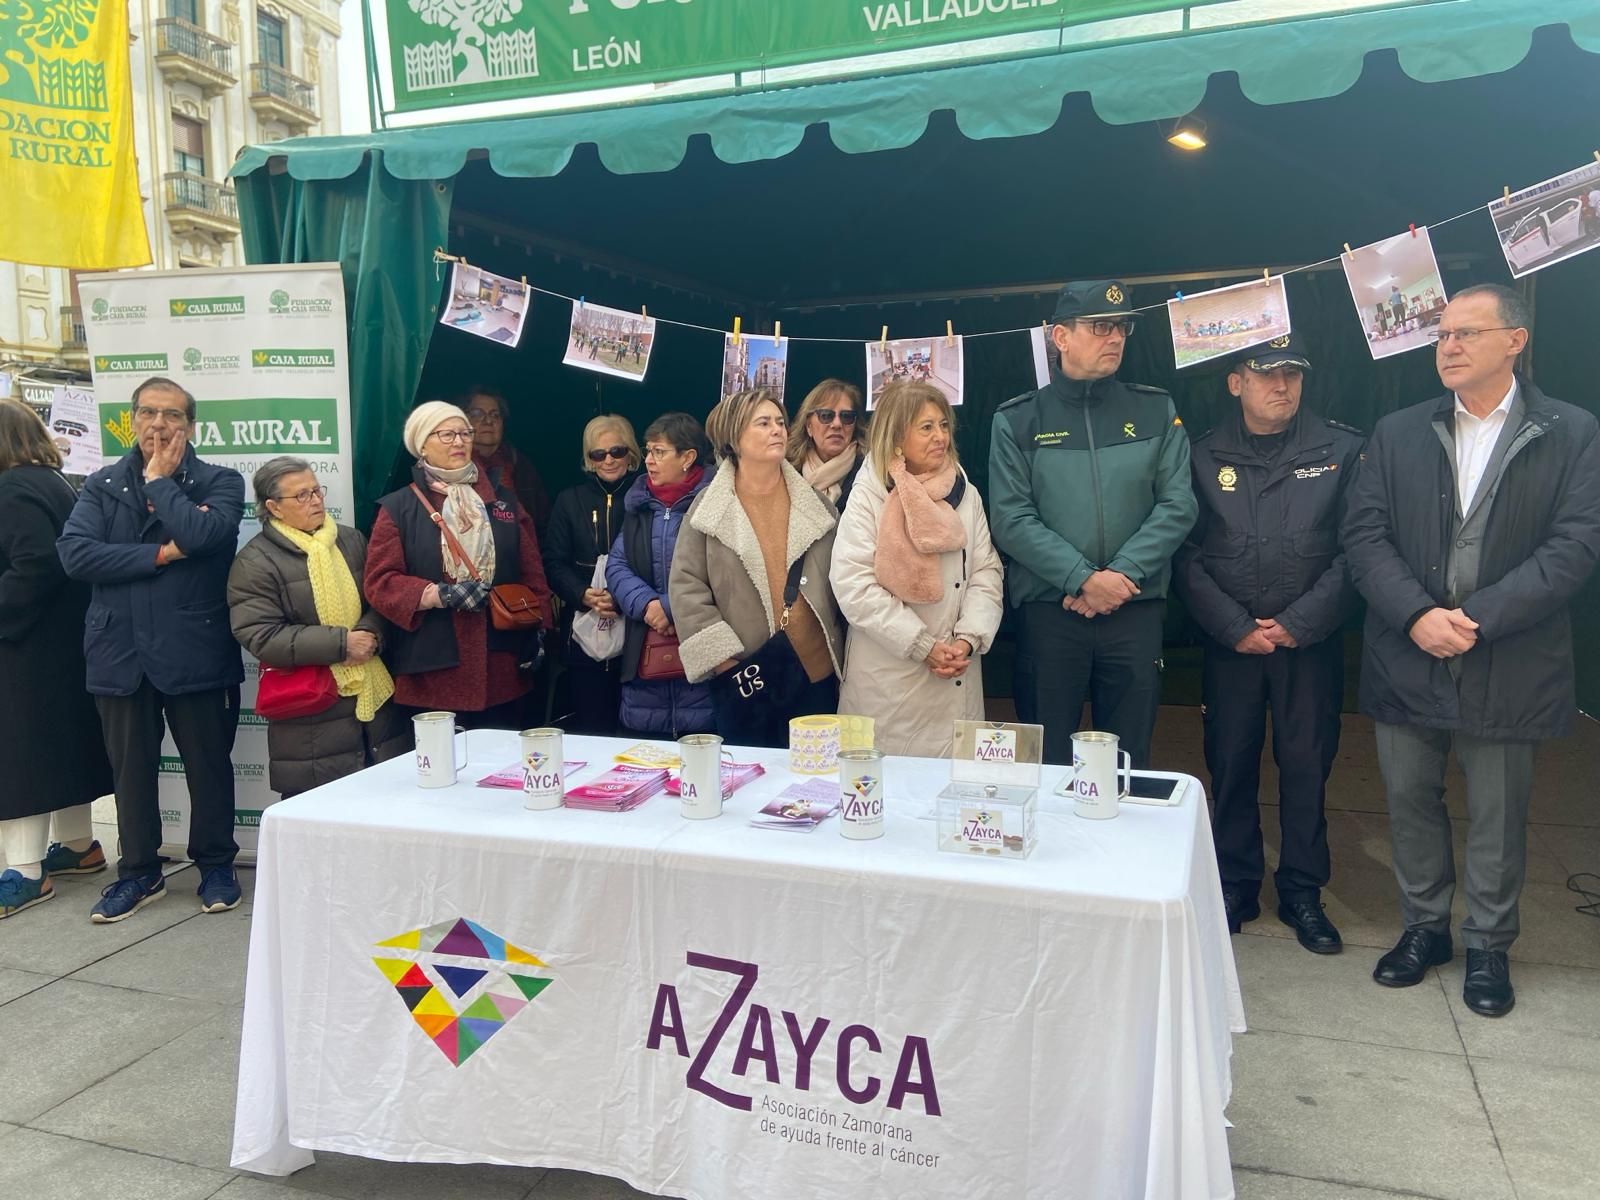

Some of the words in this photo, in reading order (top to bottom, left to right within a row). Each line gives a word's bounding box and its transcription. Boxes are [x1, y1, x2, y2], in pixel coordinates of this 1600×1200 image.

[863, 0, 1059, 32] VALLAD
[572, 36, 642, 72] LEÓN
[9, 137, 112, 168] RURAL
[187, 303, 210, 314] CAJA
[212, 302, 244, 313] RURAL
[110, 360, 134, 370] CAJA
[135, 359, 167, 369] RURAL
[268, 355, 296, 365] CAJA
[298, 355, 333, 365] RURAL
[230, 419, 332, 447] RURAL
[1293, 466, 1330, 475] OLICIA
[732, 664, 760, 685] TO
[739, 676, 765, 698] US
[976, 740, 1014, 761] AZAYCA
[962, 819, 1003, 842] AZAYCA
[646, 950, 943, 1118] AZAYCA
[761, 1094, 838, 1127] Asociación
[841, 1112, 914, 1143] Zamorana
[760, 1116, 777, 1134] de
[780, 1123, 822, 1147] ayuda
[826, 1131, 867, 1156] frente
[871, 1142, 885, 1158] al
[889, 1145, 940, 1169] cáncer
